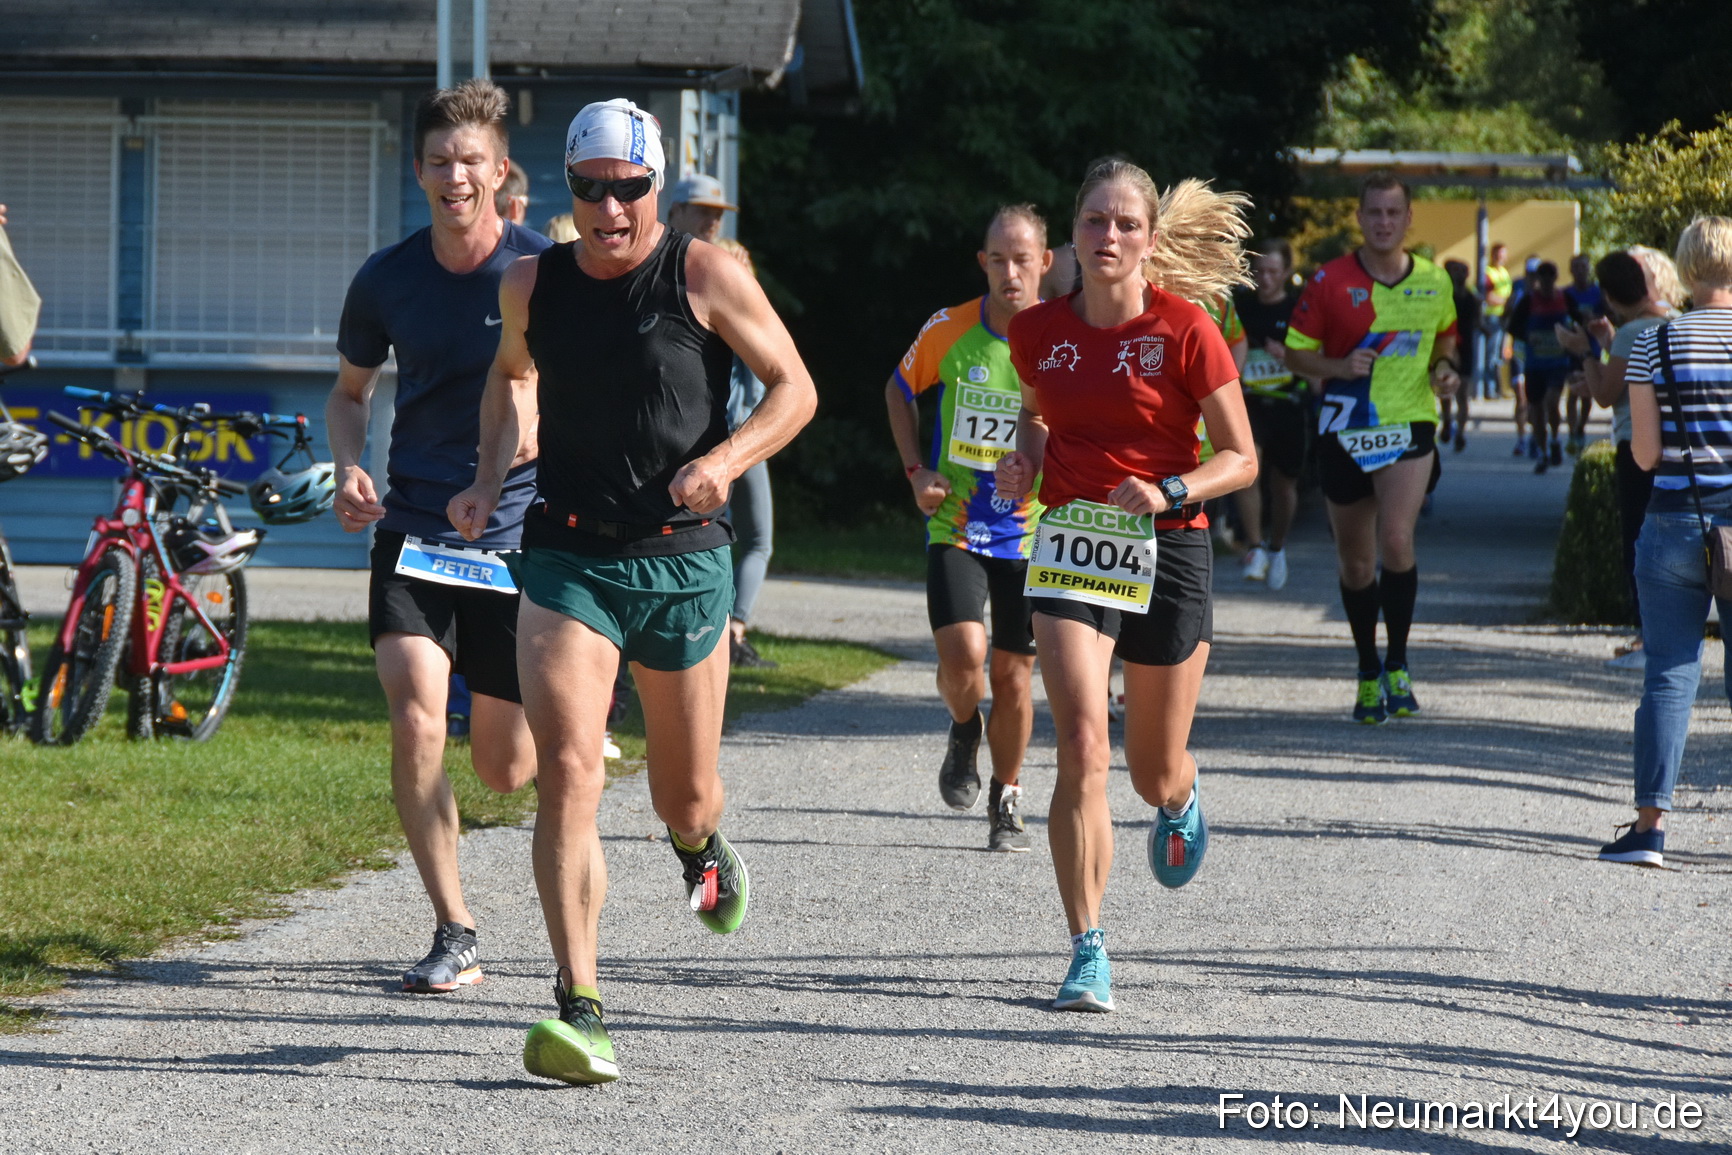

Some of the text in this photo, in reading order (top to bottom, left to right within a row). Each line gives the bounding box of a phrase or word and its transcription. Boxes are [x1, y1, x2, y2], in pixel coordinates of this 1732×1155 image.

[1347, 432, 1403, 454] 2682
[1049, 504, 1144, 535] BOCK
[1050, 533, 1141, 575] 1004
[432, 558, 493, 581] PETER
[1038, 571, 1139, 598] STEPHANIE
